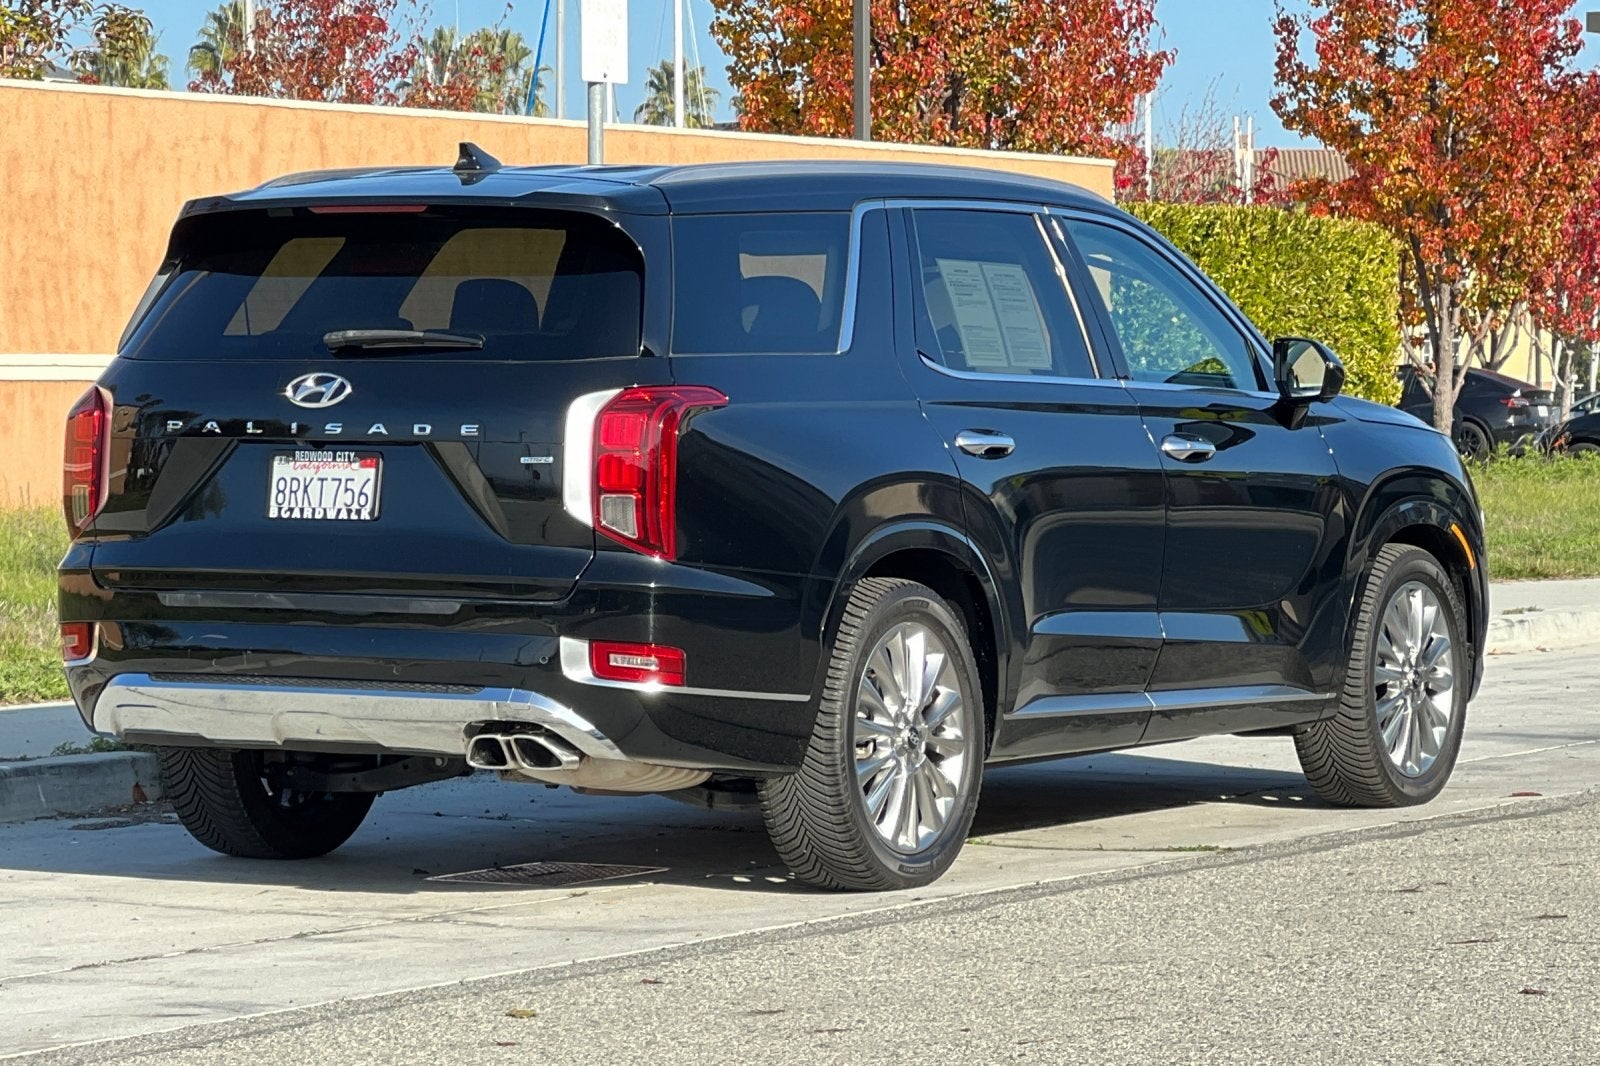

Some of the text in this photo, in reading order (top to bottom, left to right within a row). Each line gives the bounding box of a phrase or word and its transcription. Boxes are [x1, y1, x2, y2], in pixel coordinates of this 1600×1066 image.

[166, 420, 481, 436] PALISADE
[295, 450, 333, 462] REDWOOD
[336, 451, 355, 462] CITY
[275, 477, 371, 508] 8RKT756
[269, 507, 371, 520] BOARDWALK
